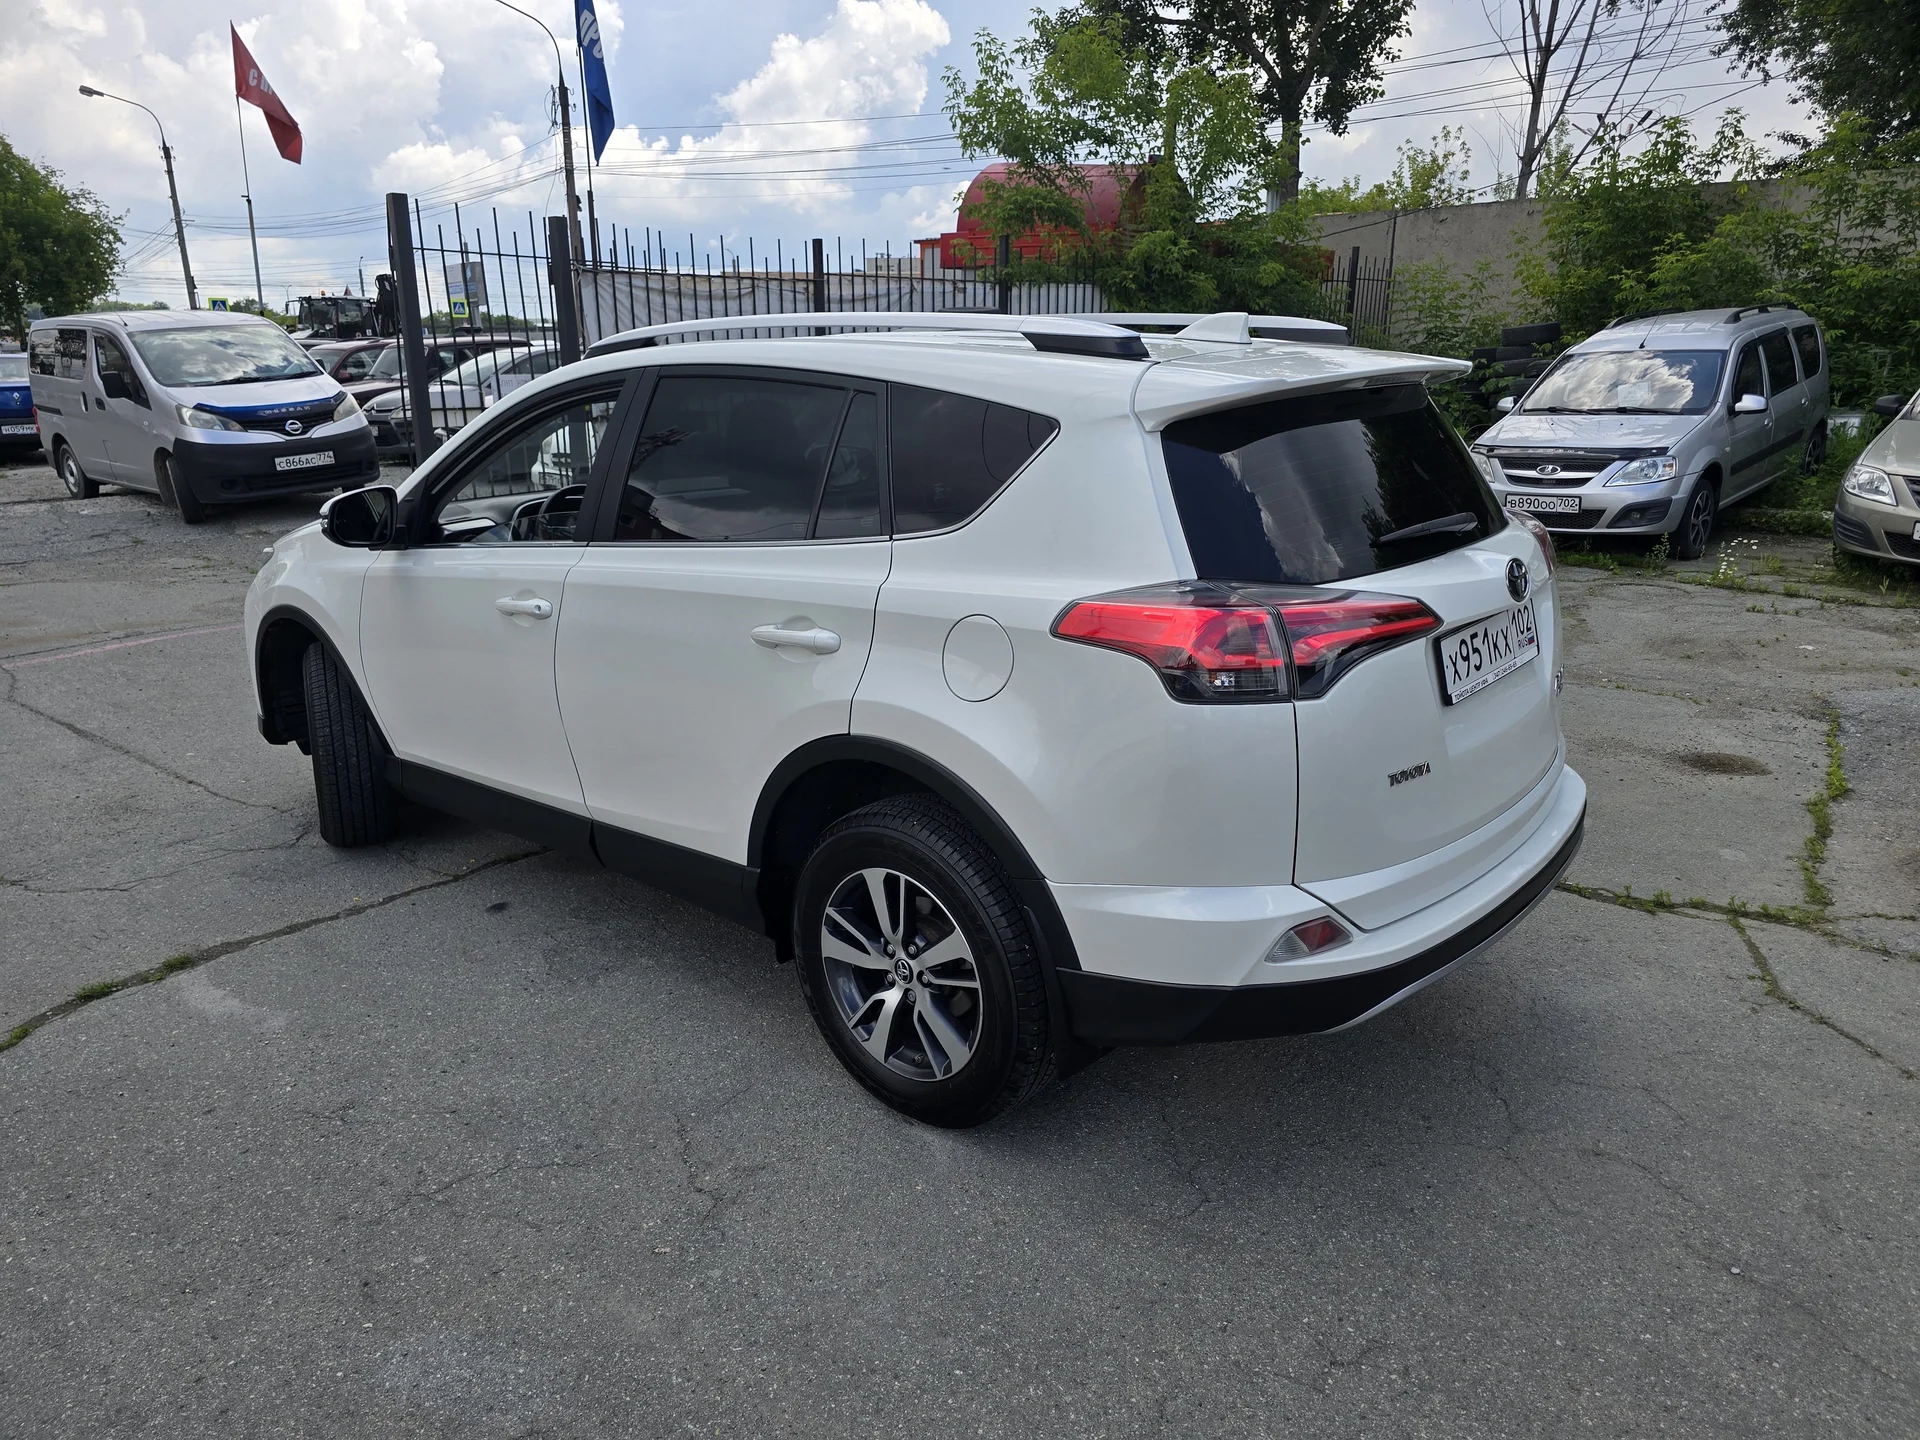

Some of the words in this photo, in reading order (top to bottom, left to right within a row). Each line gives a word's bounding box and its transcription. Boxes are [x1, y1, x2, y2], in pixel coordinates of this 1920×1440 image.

[317, 452, 333, 462] 774
[1558, 498, 1576, 508] 702
[1511, 605, 1532, 638] 102
[1517, 635, 1529, 650] RUS
[1388, 760, 1431, 787] TOYOTA
